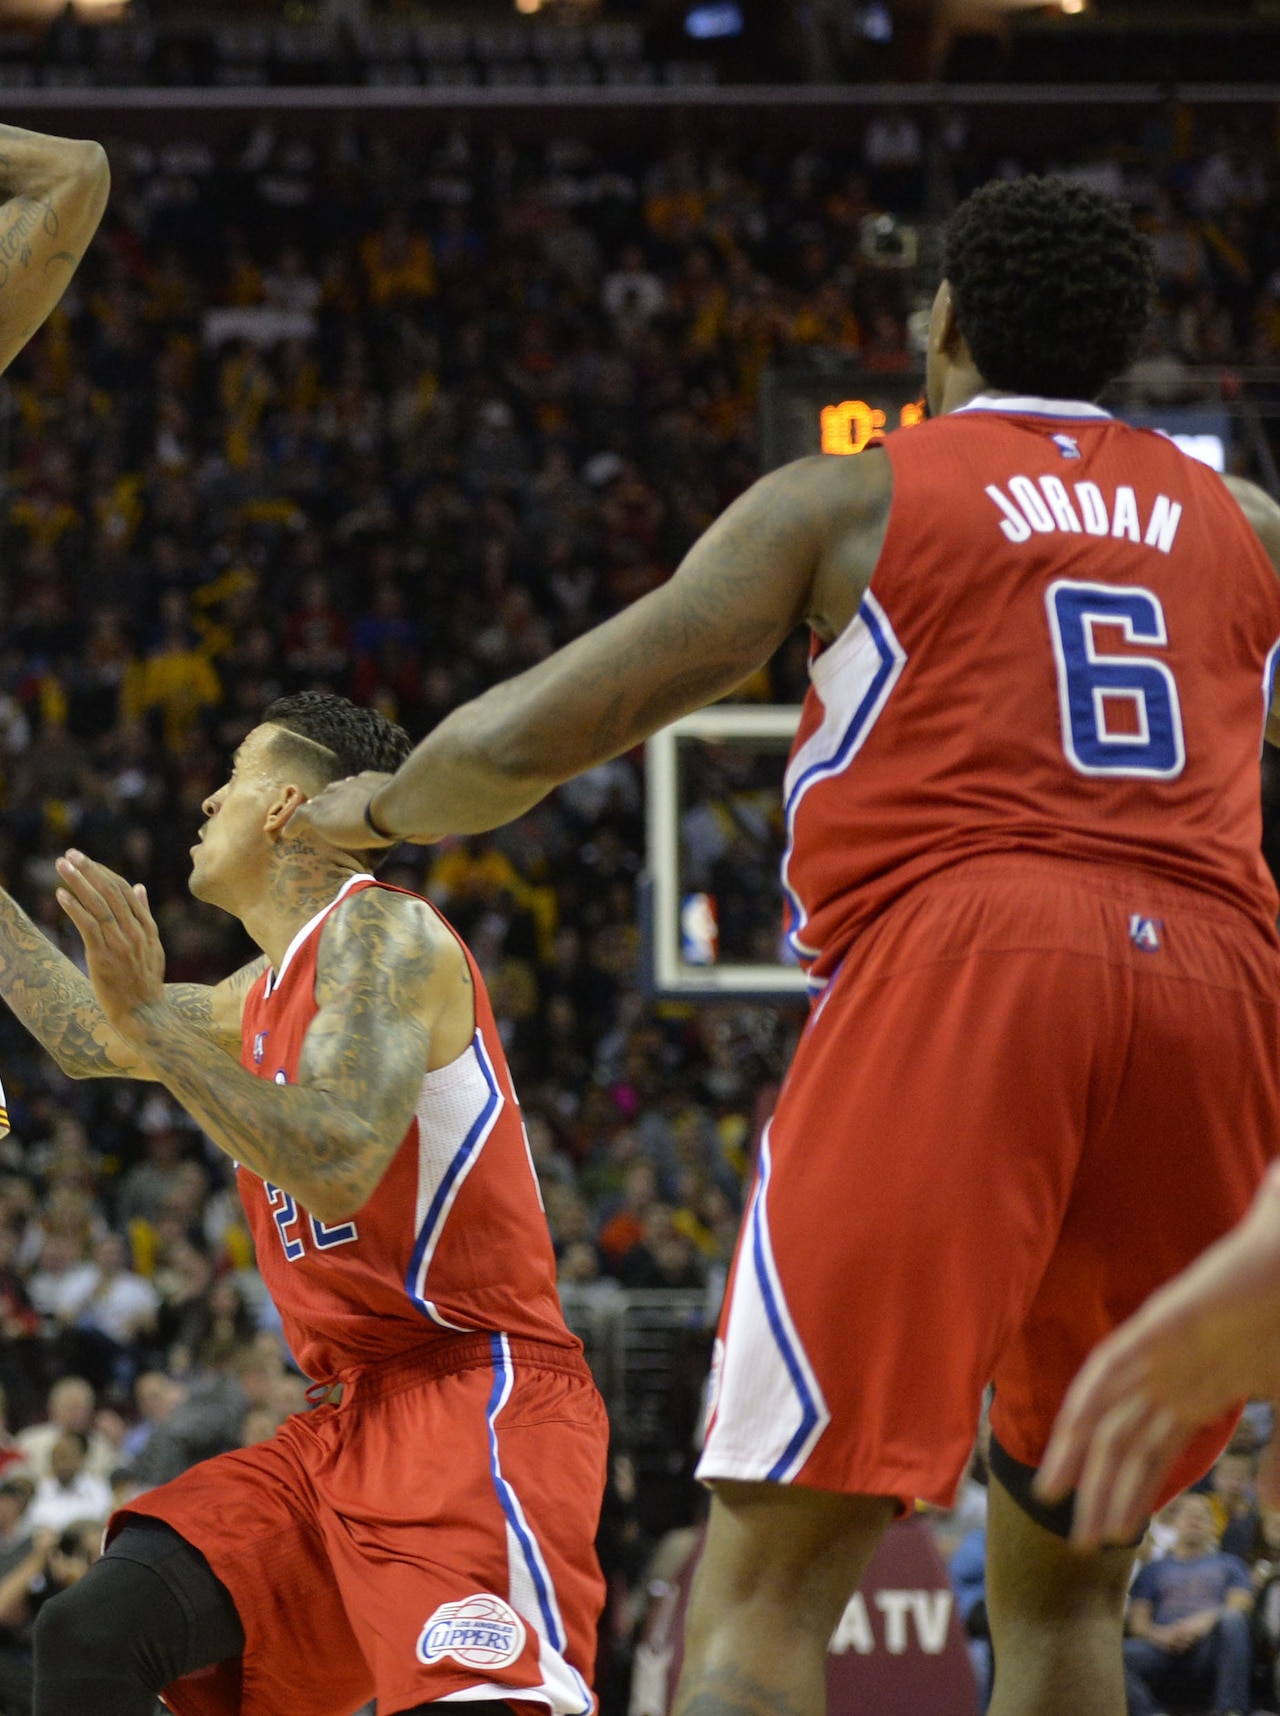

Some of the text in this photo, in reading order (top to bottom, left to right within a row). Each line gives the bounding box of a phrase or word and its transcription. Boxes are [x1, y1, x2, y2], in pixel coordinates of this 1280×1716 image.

[984, 474, 1183, 554] JORDAN
[1045, 579, 1186, 779] 6
[421, 1620, 513, 1659] CLIPPERS
